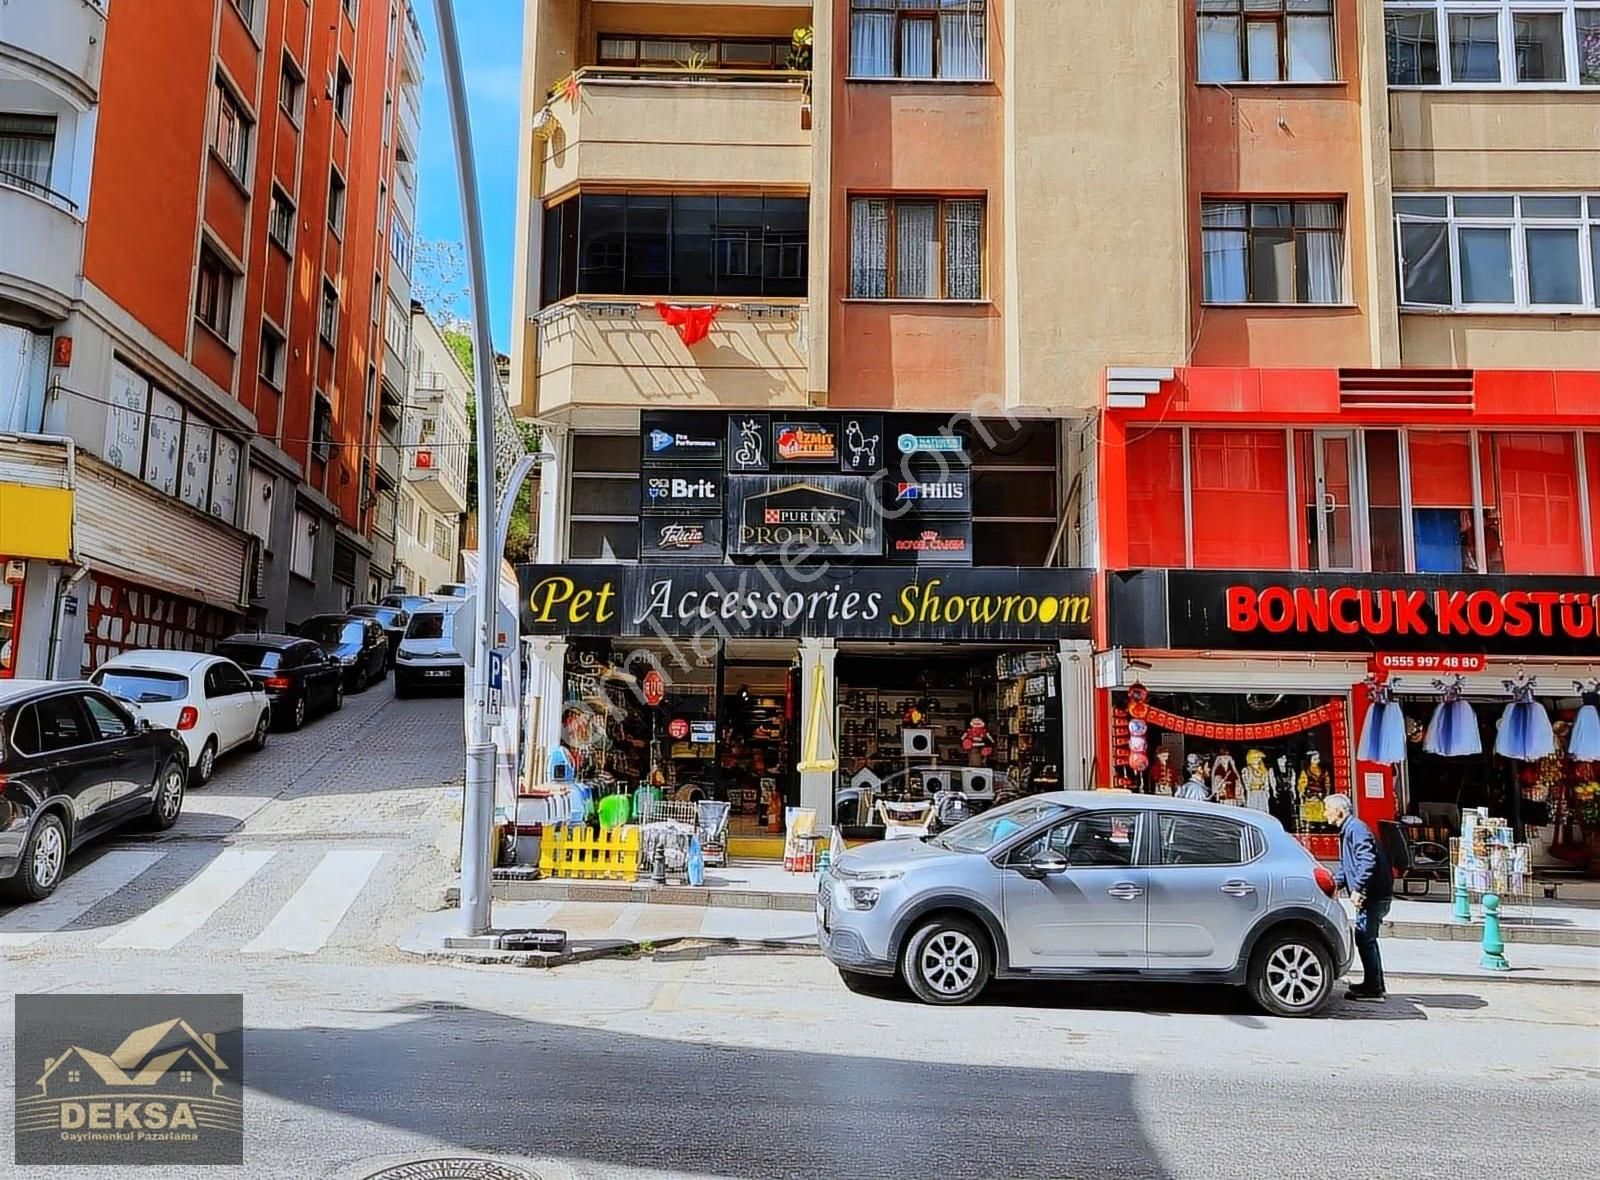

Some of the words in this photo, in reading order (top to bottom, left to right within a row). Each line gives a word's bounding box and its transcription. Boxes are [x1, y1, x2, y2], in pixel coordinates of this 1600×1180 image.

[671, 478, 716, 498] Brit
[921, 482, 964, 499] Hill's
[781, 511, 836, 522] PURINA
[740, 527, 792, 544] PRO
[798, 527, 864, 545] PLAN
[529, 576, 616, 625] Pet
[632, 578, 882, 625] Accessories
[890, 578, 1092, 626] Showroom
[1226, 585, 1429, 636] BONCUK
[1434, 588, 1600, 640] KOSTÜ
[1383, 655, 1415, 667] 0555
[1417, 656, 1440, 667] 997
[1443, 657, 1459, 668] 48
